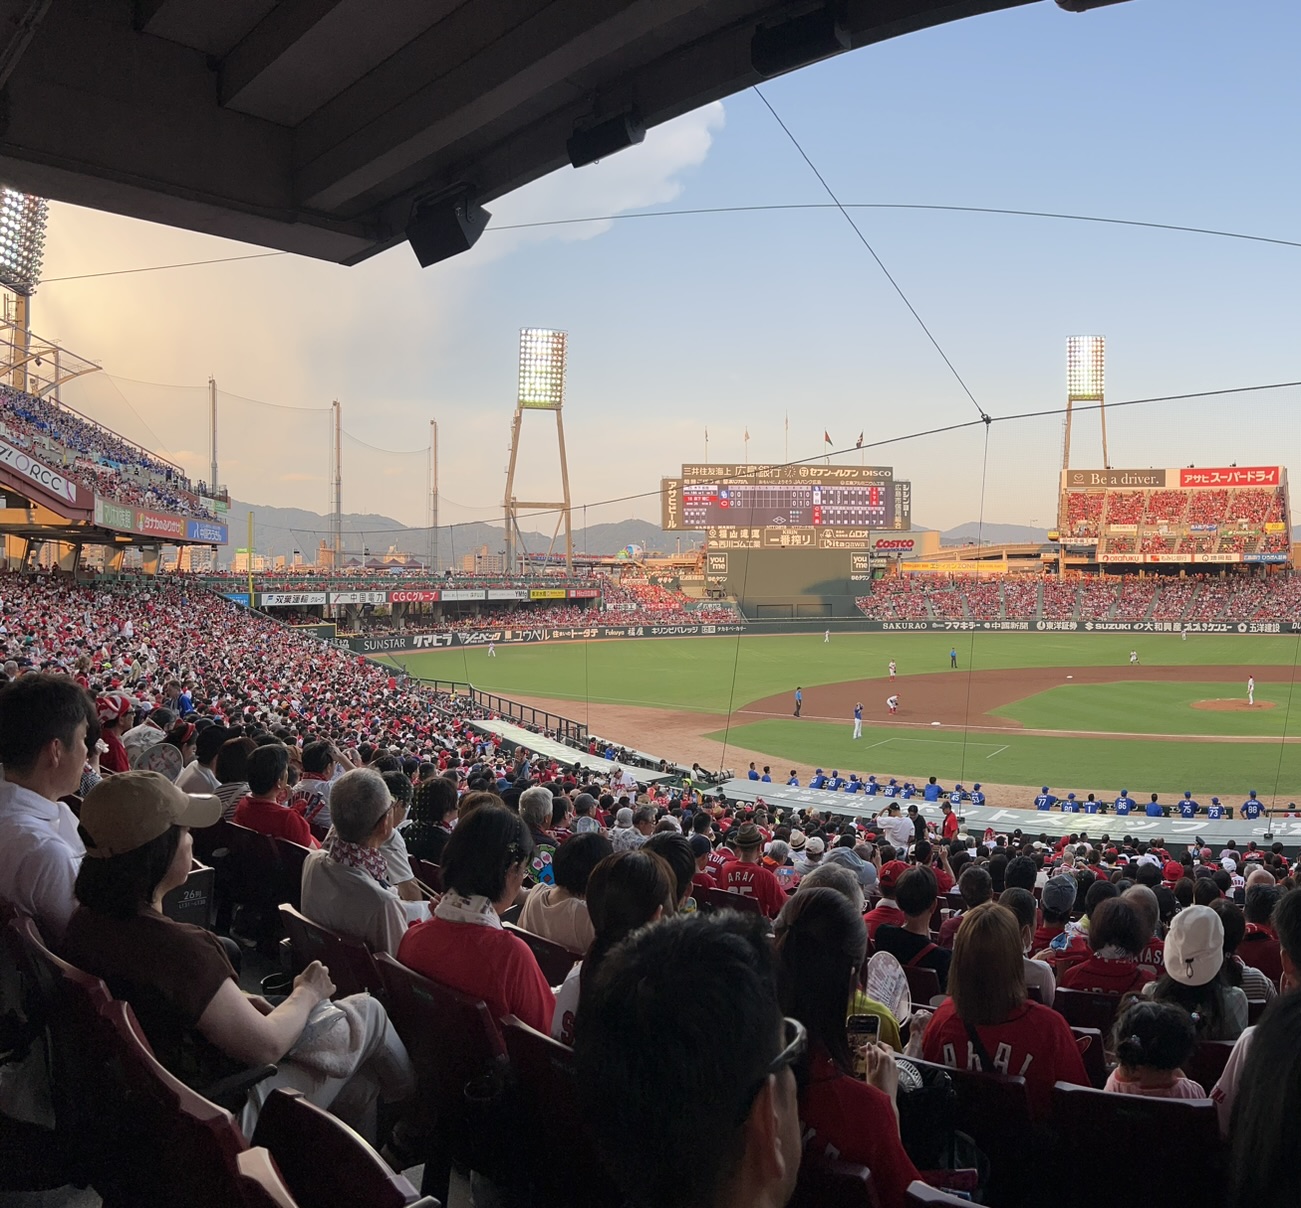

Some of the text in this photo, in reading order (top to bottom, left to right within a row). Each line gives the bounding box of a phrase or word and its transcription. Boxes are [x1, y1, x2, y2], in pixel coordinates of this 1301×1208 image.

[683, 467, 732, 476] 三井住友海上
[735, 465, 782, 478] 広島銀行
[1184, 470, 1275, 483] アサヒ スーパードライ
[29, 464, 62, 491] RCC
[1091, 473, 1159, 485] Be a driver.
[667, 481, 678, 529] アサヒビール
[874, 538, 915, 549] COSTCO
[709, 556, 725, 565] you
[852, 556, 868, 565] you
[882, 622, 927, 630] SAKURAO
[363, 638, 406, 651] SUNSTAR
[1038, 798, 1047, 807] 77
[1182, 805, 1192, 814] 75
[1209, 809, 1219, 817] 73
[1247, 805, 1258, 814] 88
[727, 871, 755, 883] ARAI
